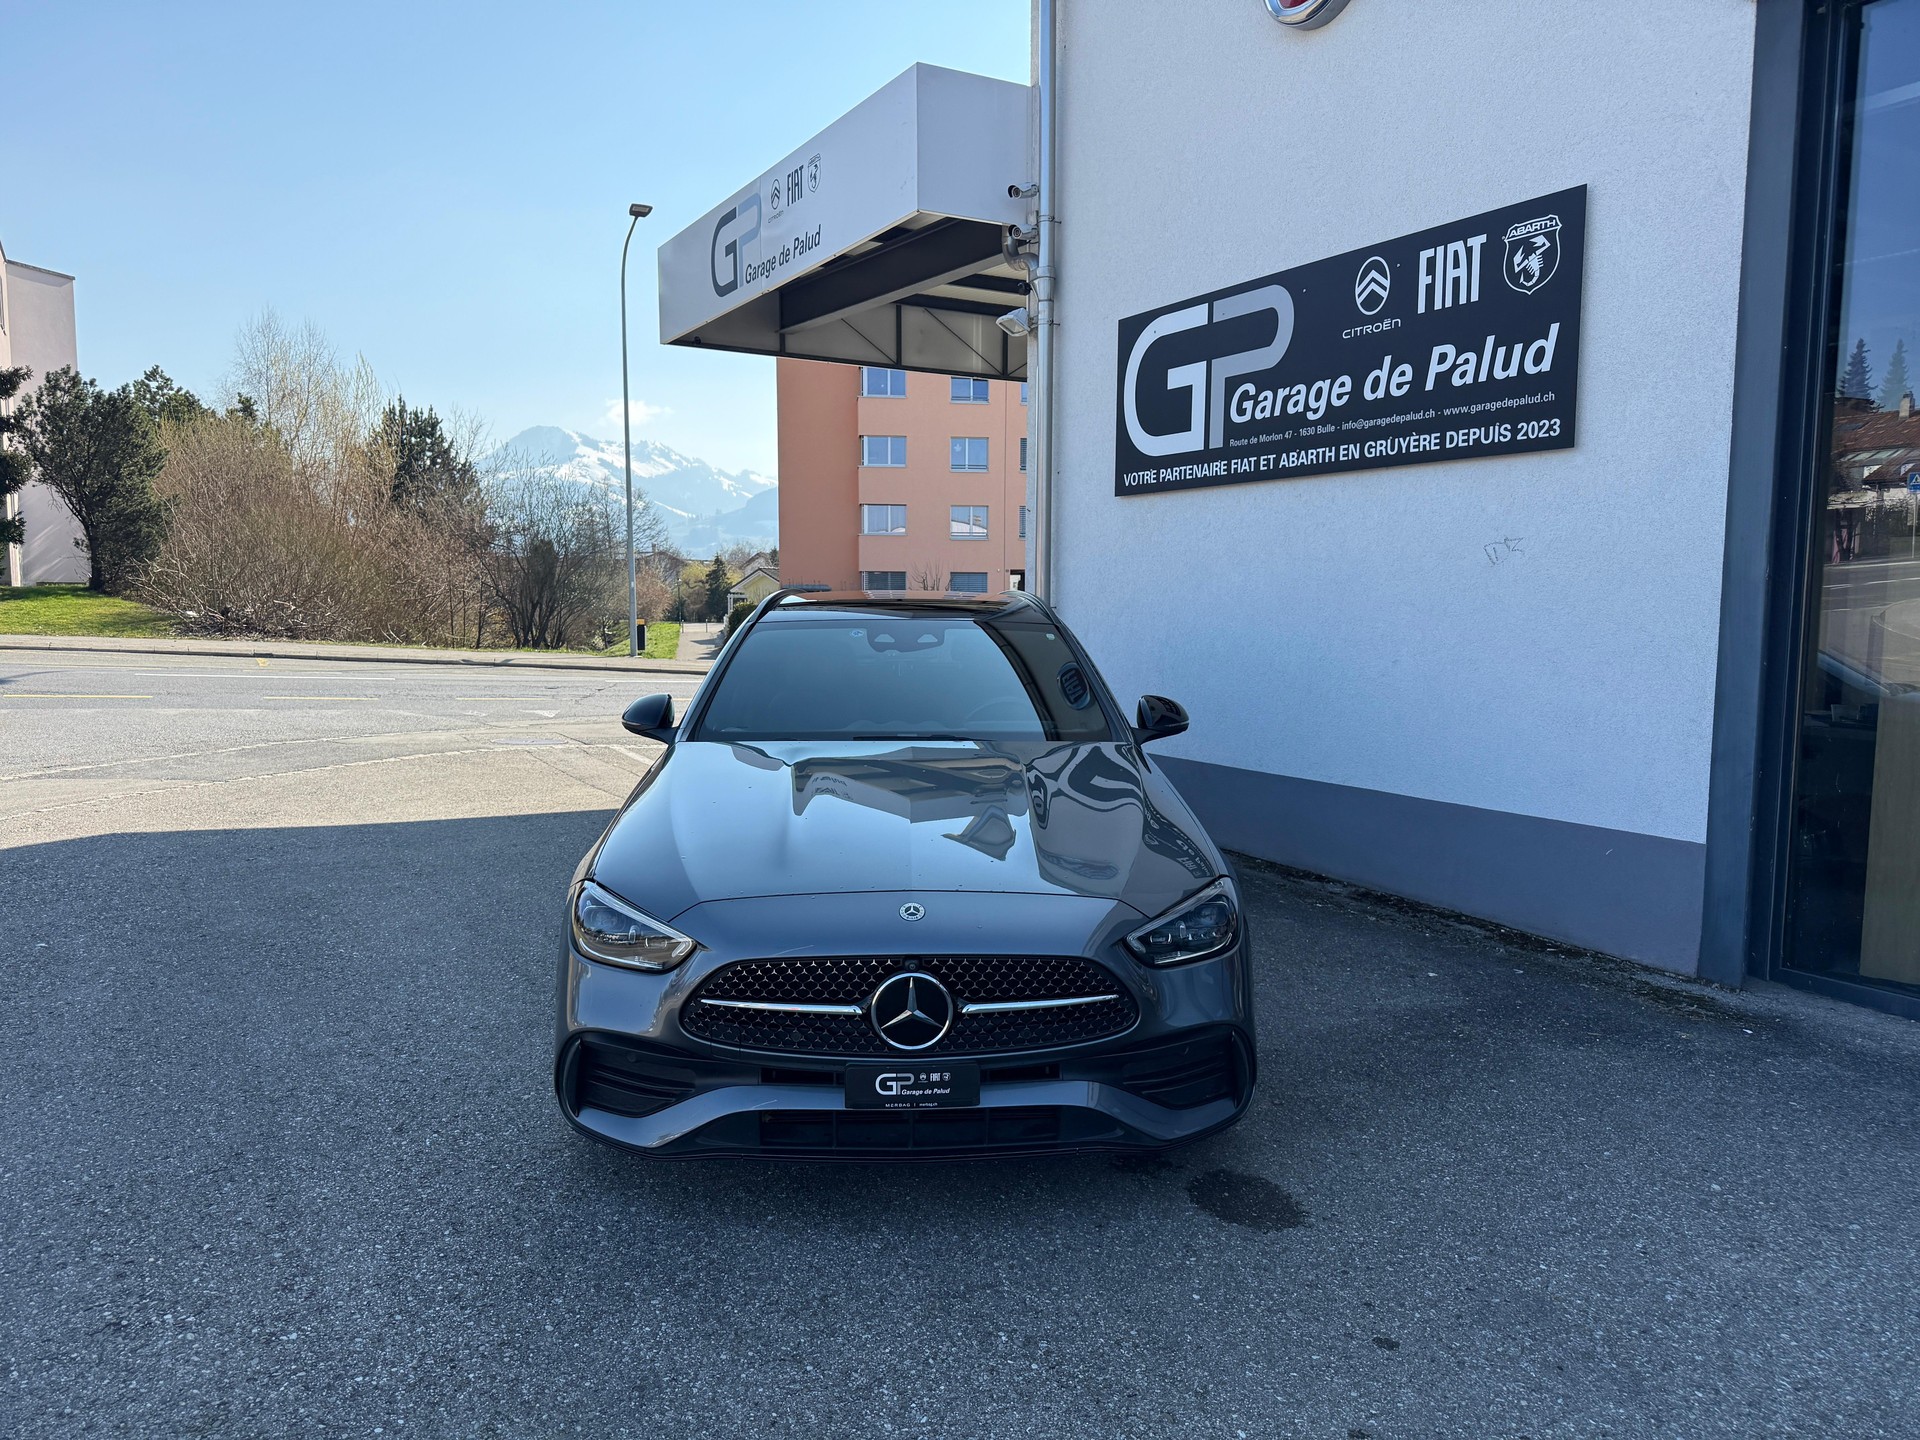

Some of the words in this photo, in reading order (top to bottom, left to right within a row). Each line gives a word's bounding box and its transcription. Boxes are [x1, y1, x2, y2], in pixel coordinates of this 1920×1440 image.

[787, 165, 804, 207] FIAT
[1508, 219, 1557, 238] ABARTH
[745, 255, 776, 284] Garage
[779, 244, 790, 266] de
[793, 224, 821, 259] Palud
[1417, 233, 1487, 314] FIAT
[1342, 318, 1401, 339] CITROËN
[1229, 373, 1352, 423] Garage
[1363, 355, 1413, 401] de
[1425, 322, 1560, 391] Palud
[1229, 437, 1249, 448] Route
[1250, 436, 1258, 445] de
[1259, 433, 1283, 443] Morlon
[1285, 431, 1293, 439] 47
[1299, 427, 1315, 437] 1630
[1317, 423, 1335, 434] Bulle
[1341, 408, 1435, 430] info@garagedepalud.ch
[1443, 391, 1555, 416] www.garagedepalud.ch
[1123, 468, 1157, 487] VOTRE
[1159, 460, 1228, 483] PARTENAIRE
[1231, 457, 1257, 474] FIAT
[1260, 454, 1276, 470] ET
[1279, 447, 1335, 469] ABARTH
[1339, 443, 1360, 461] EN
[1364, 433, 1440, 459] GRUYÈRE
[1446, 423, 1512, 449] DEPUIS
[1517, 418, 1561, 440] 2023
[901, 1088, 923, 1096] Garage
[930, 1072, 941, 1082] FIAT
